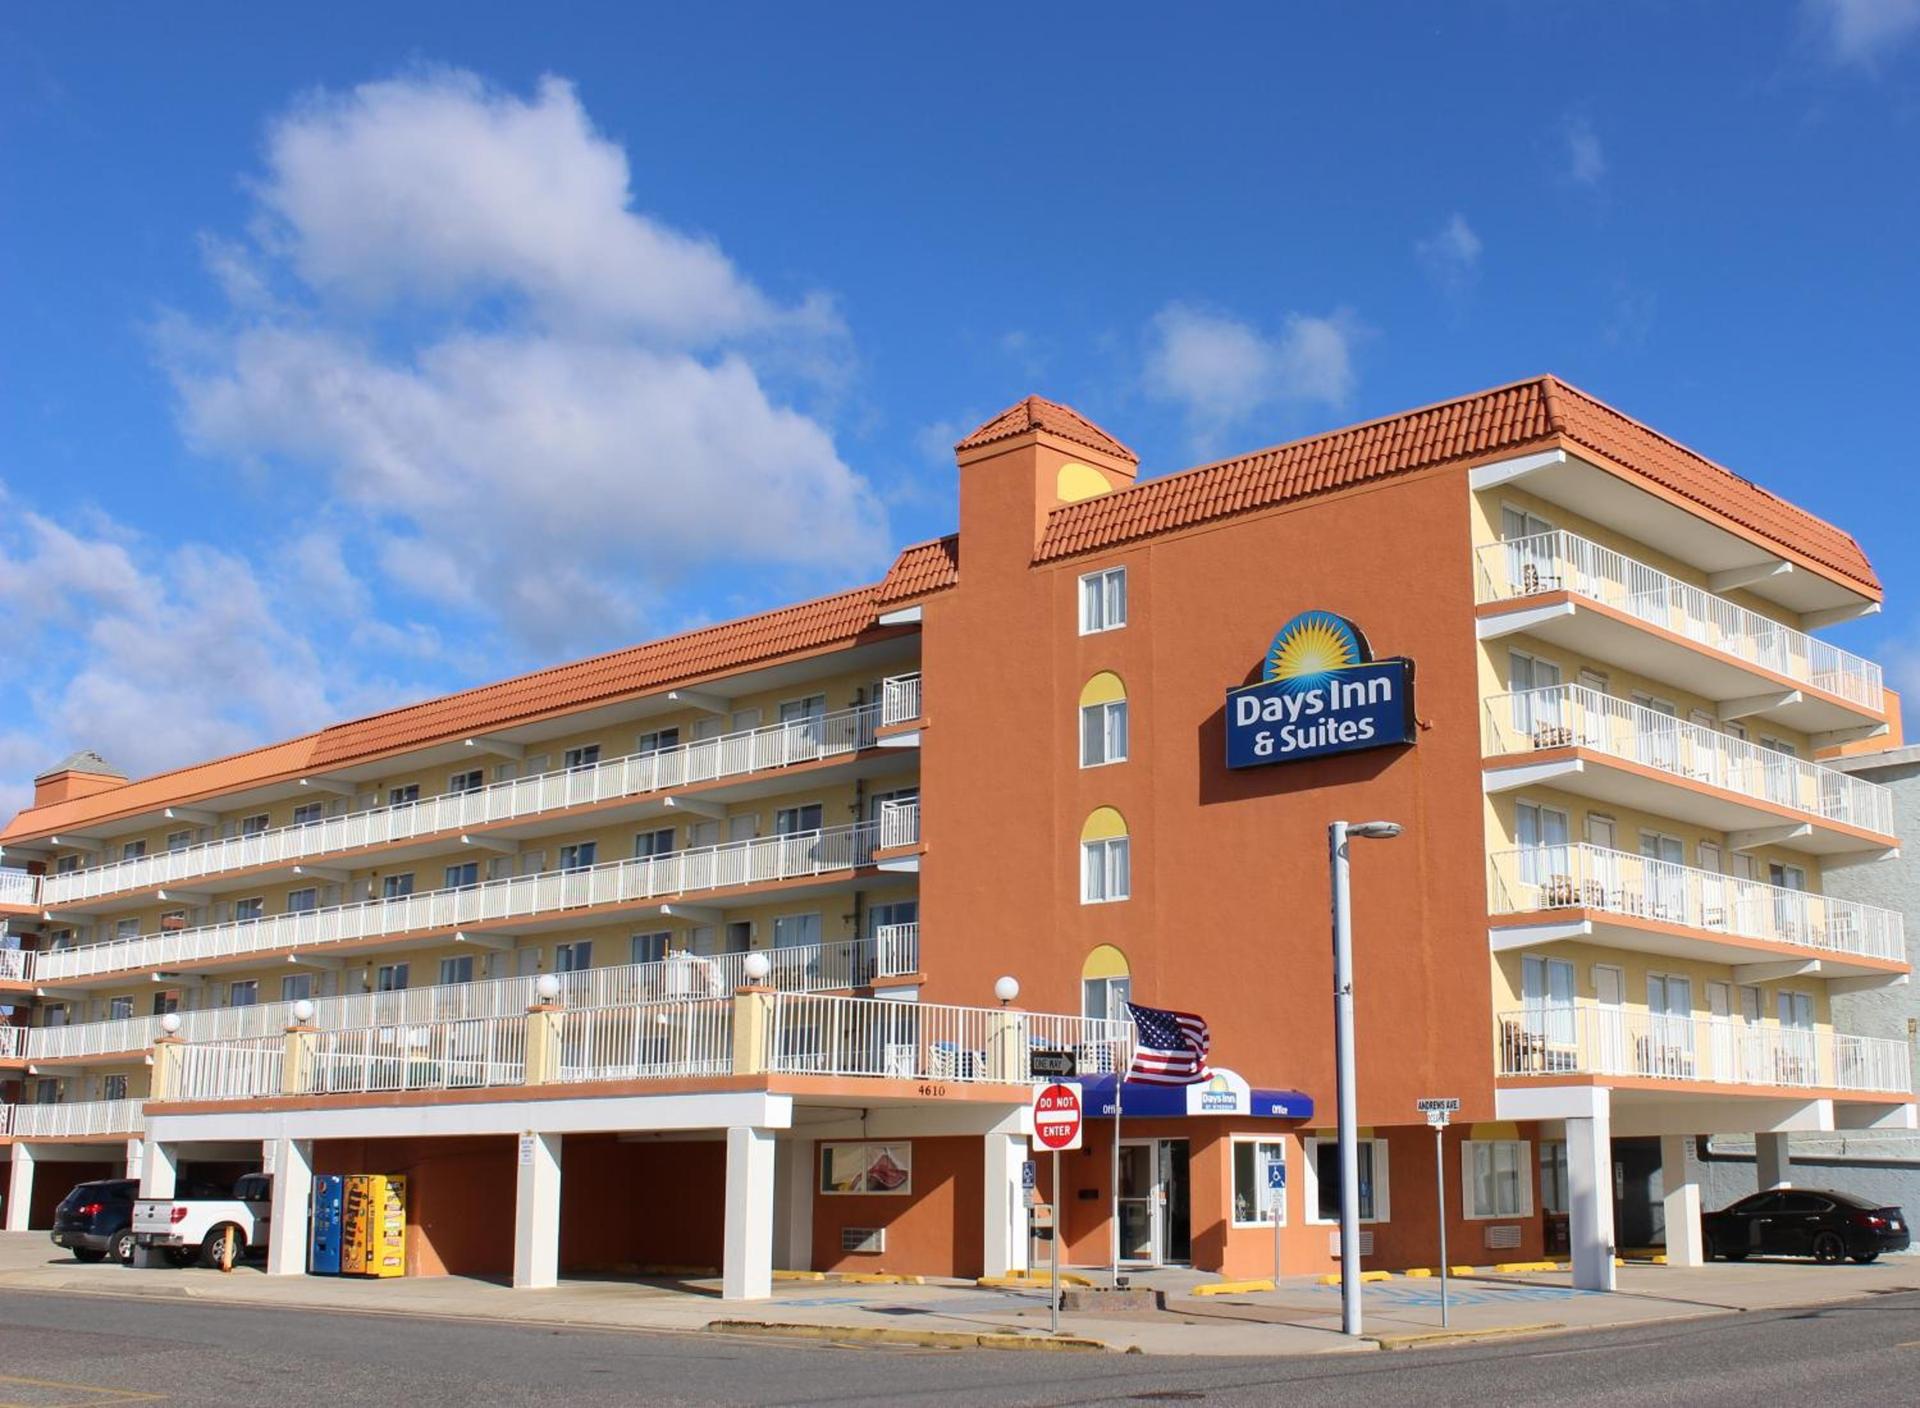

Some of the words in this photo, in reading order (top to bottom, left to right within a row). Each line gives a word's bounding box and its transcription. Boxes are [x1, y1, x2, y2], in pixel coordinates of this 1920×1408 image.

[1236, 689, 1324, 727] Days
[1330, 676, 1392, 711] Inn
[1253, 731, 1275, 756] &
[1280, 717, 1375, 752] Suites
[1034, 1058, 1049, 1069] ONE
[1049, 1059, 1062, 1070] WAY
[918, 1085, 946, 1096] 4610
[1040, 1098, 1052, 1108] DO
[1056, 1097, 1074, 1108] NOT
[1202, 1093, 1221, 1103] Days
[1222, 1093, 1236, 1103] Inn
[1102, 1104, 1123, 1115] Offie
[1271, 1104, 1289, 1115] Office
[1418, 1101, 1444, 1110] ANDREWS
[1043, 1126, 1071, 1137] ENTER
